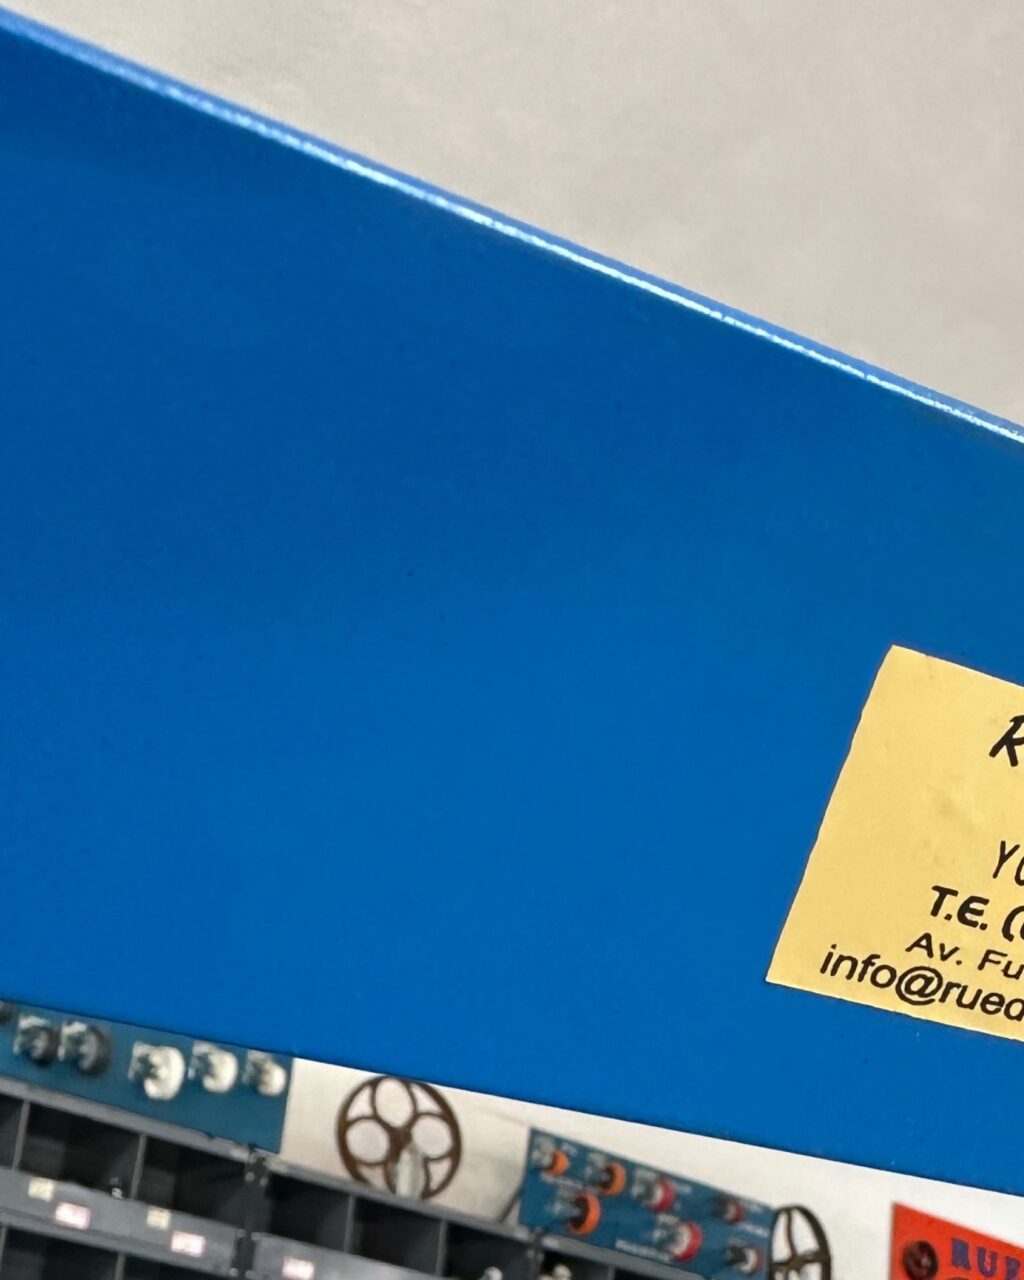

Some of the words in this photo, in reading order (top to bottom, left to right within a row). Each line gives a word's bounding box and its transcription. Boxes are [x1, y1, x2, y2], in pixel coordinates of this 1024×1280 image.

[993, 841, 1019, 878] Y
[931, 886, 988, 931] T.E.
[906, 933, 963, 966] Av.
